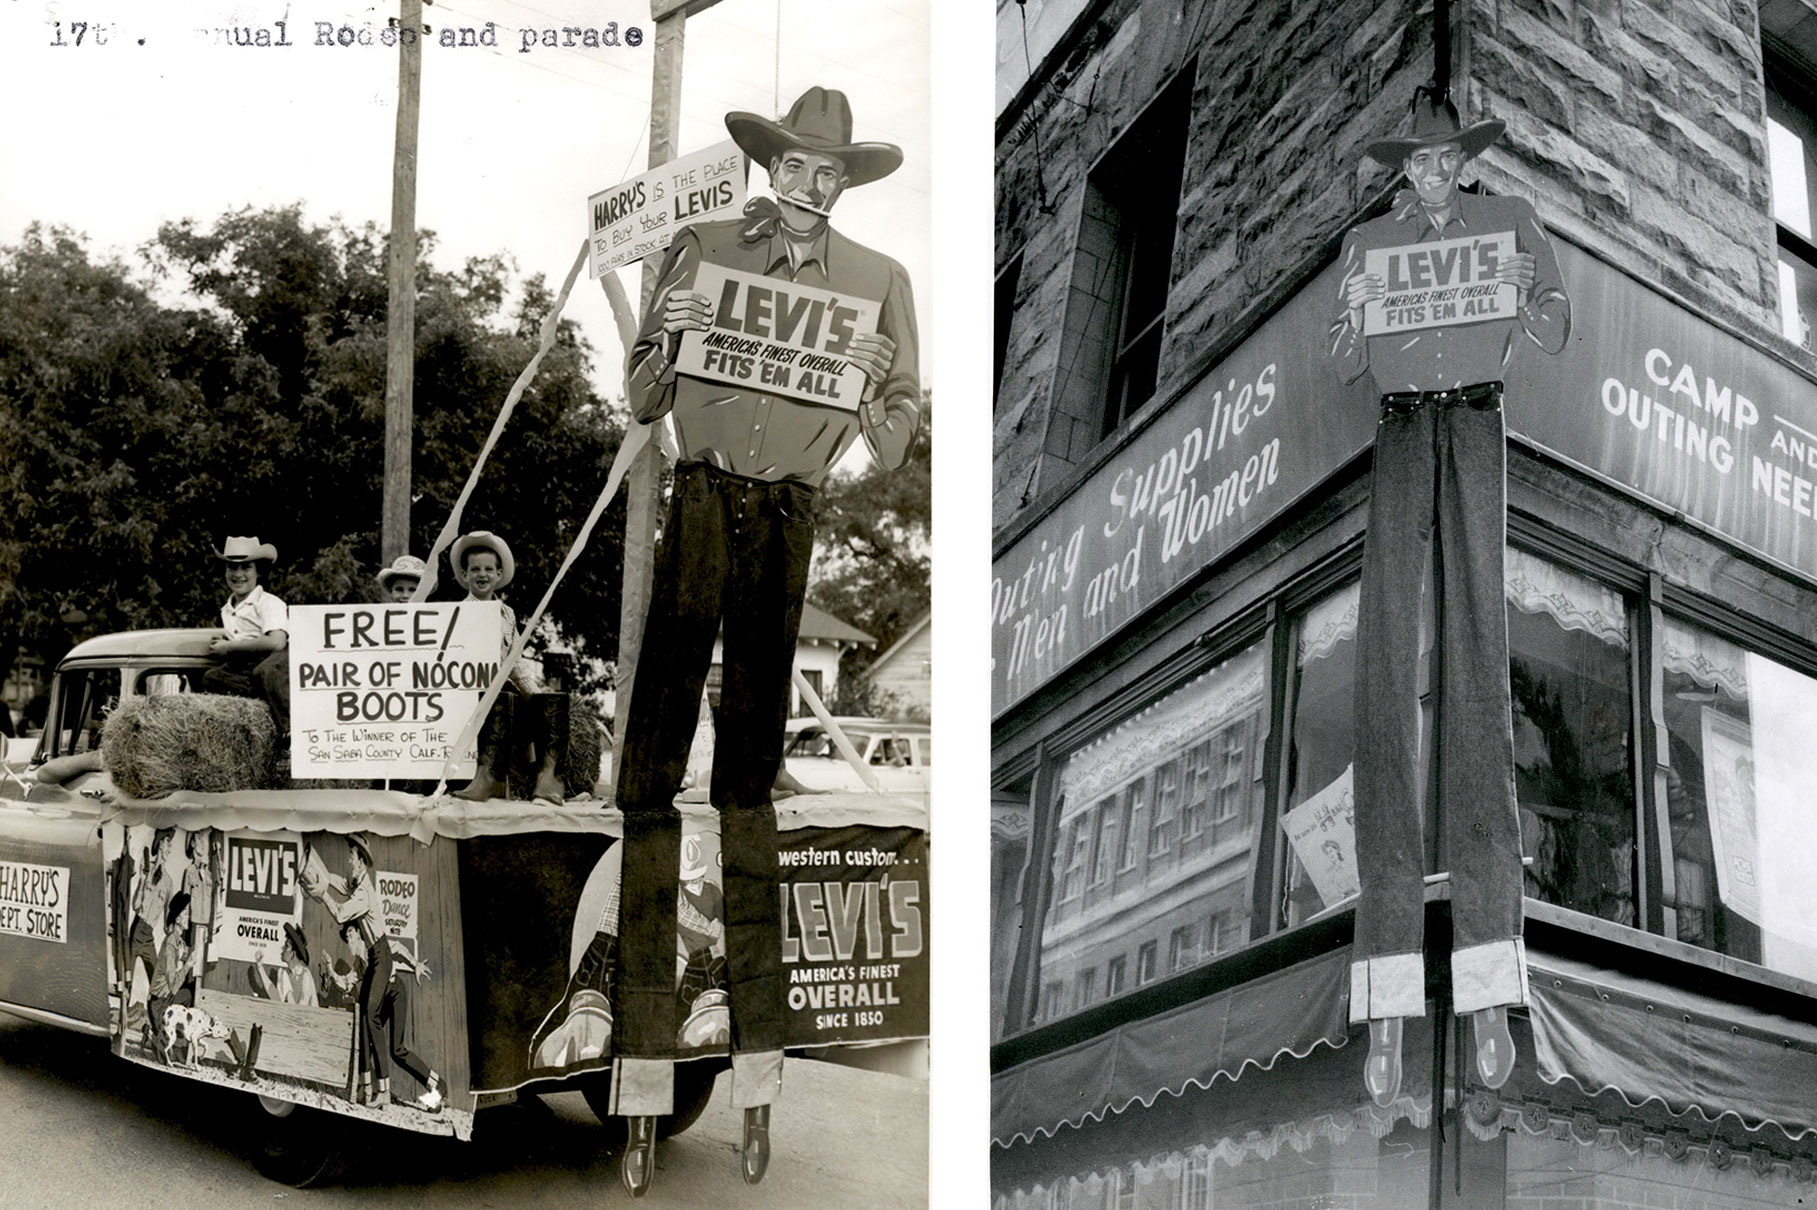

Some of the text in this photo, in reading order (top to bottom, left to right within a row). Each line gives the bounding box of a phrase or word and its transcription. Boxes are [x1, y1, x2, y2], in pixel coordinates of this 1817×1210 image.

[594, 156, 738, 231] HARRY'S IS THE PLACE
[594, 181, 734, 252] TO BUY YOUR LEVIS
[1388, 239, 1499, 293] LEVI'S
[1428, 287, 1460, 303] FINEST
[1461, 283, 1501, 300] OVERALL
[714, 278, 859, 356] LEVI'S
[1386, 297, 1500, 326] FITS 'EM ALL
[702, 332, 849, 377] AMERICA'S FINEST OVERALL
[703, 350, 841, 399] FITS 'EM ALL
[1644, 348, 1760, 431] CAMP
[1104, 363, 1277, 538] Supplies
[1601, 378, 1817, 521] OUTING NEE
[1083, 524, 1145, 619] and
[1158, 437, 1280, 564] Women
[324, 606, 460, 662] FREE!
[299, 661, 362, 688] PAIR
[368, 661, 402, 687] OF
[337, 692, 444, 721] BOOTS
[324, 729, 346, 743] THE
[401, 732, 417, 742] OF
[422, 728, 448, 743] THE
[308, 746, 331, 760] SAN
[334, 745, 363, 759] SABA
[365, 744, 403, 759] COUNTY
[230, 844, 296, 897] LEVI'S
[778, 847, 841, 866] western
[0, 866, 59, 907] HARRY'S
[379, 879, 415, 899] RODEO
[0, 906, 62, 938] EPT. STORE
[238, 916, 264, 925] AMERICA'S
[382, 899, 411, 919] Dance
[779, 873, 923, 963] LEVI'S
[237, 924, 279, 942] OVERALL
[790, 964, 900, 983] AMERICA'S FINEST
[788, 981, 900, 1011] OVERALL
[816, 1010, 884, 1030] SINCE 1850
